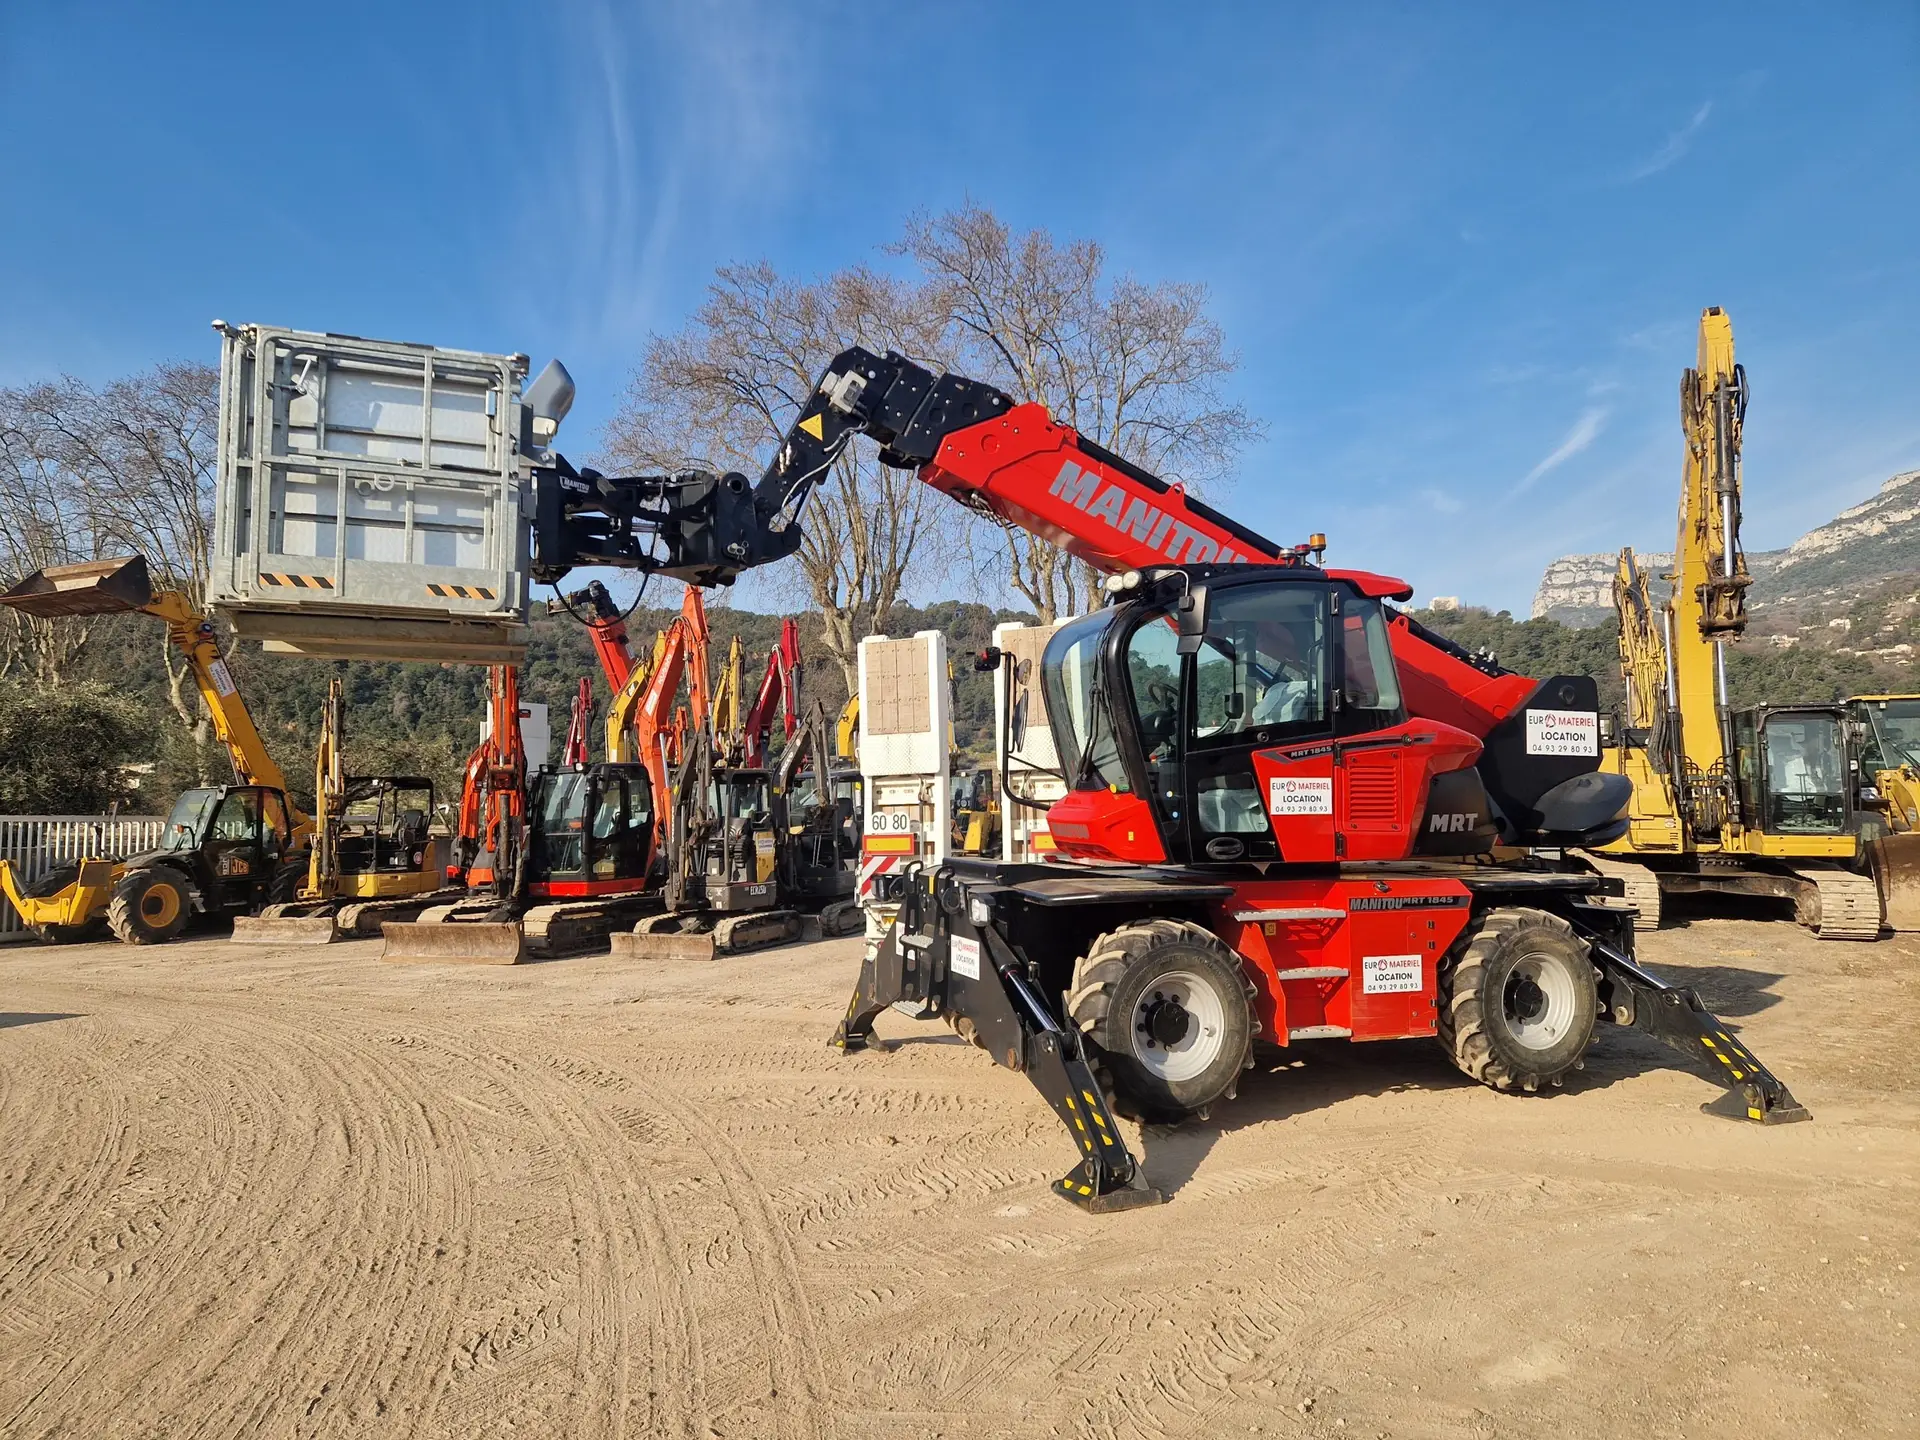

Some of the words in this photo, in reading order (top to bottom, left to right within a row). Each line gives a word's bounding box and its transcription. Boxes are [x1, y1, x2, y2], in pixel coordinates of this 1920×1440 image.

[1558, 717, 1595, 727] MATERIEL
[1541, 732, 1586, 741] LOCATION
[1290, 750, 1310, 758] MRT
[1311, 746, 1332, 755] 1845
[1532, 744, 1542, 752] 04
[1546, 744, 1555, 752] 93
[1558, 745, 1567, 753] 29
[1298, 782, 1330, 791] MATERIEL
[1283, 795, 1322, 803] LOCATION
[872, 814, 887, 830] 60
[892, 814, 907, 830] 80
[1429, 812, 1479, 833] MRT
[231, 858, 248, 873] JCB
[1350, 897, 1403, 911] MANITOU
[1403, 897, 1425, 905] MRT
[1428, 896, 1454, 904] 1845
[1389, 959, 1420, 968] MATERIEL
[1374, 973, 1412, 981] LOCATION
